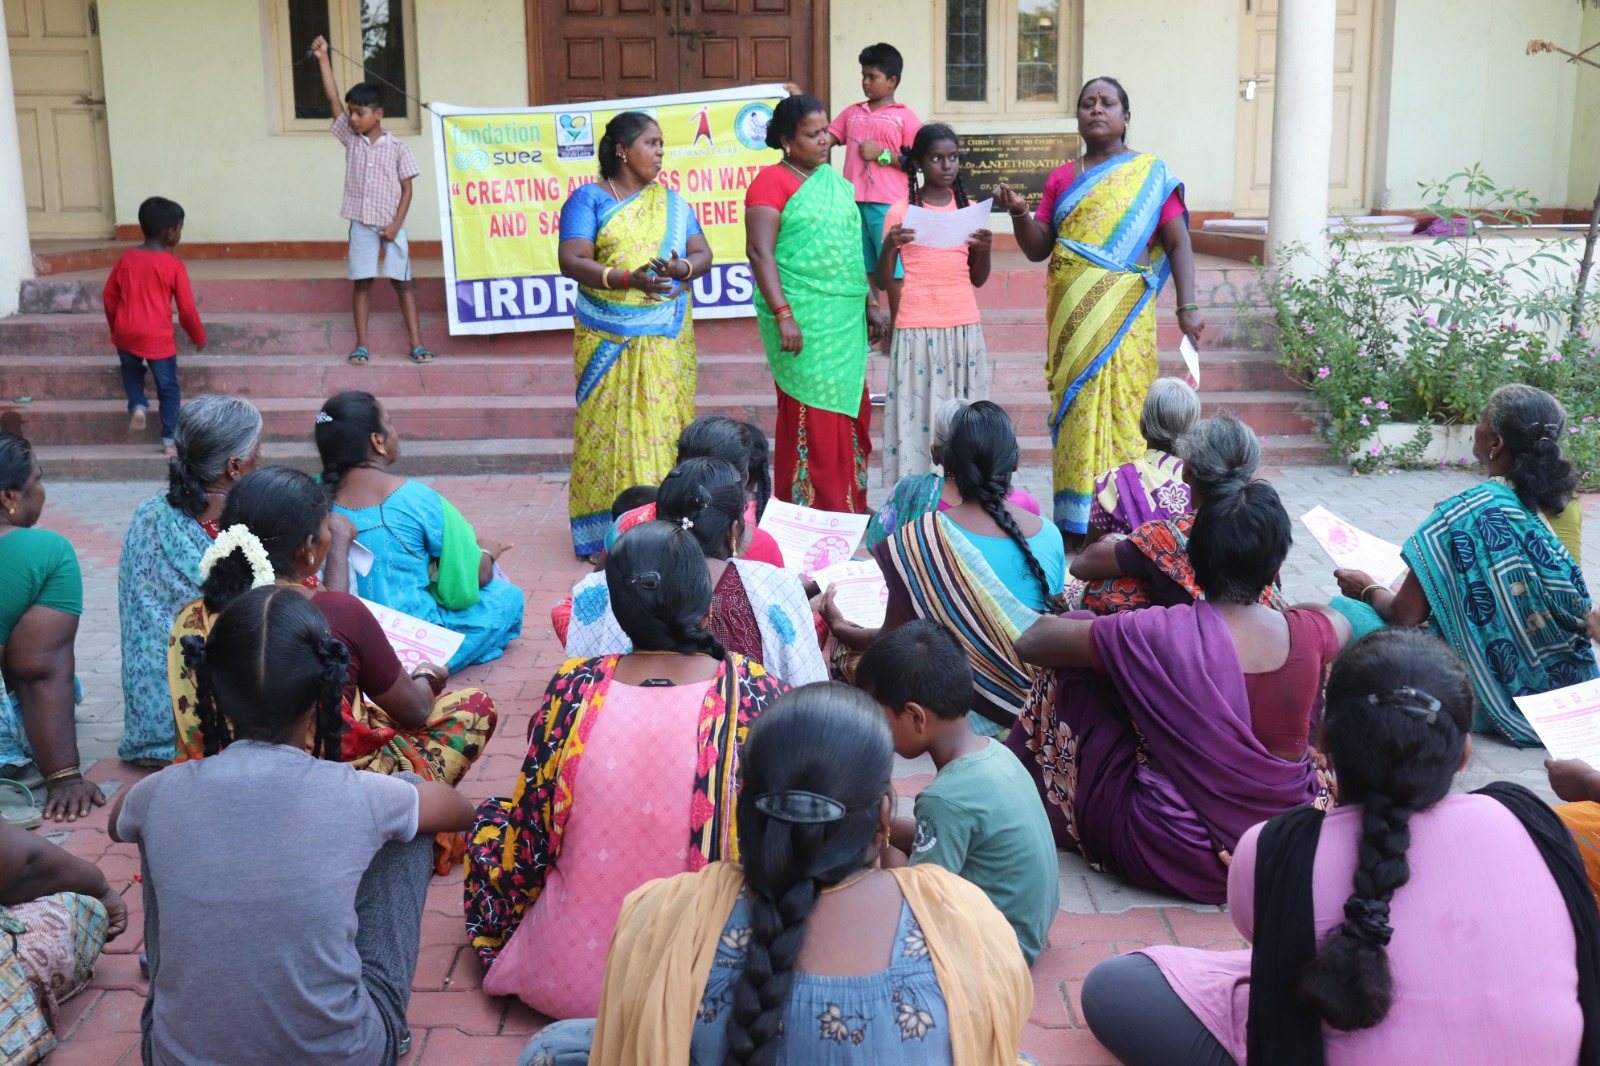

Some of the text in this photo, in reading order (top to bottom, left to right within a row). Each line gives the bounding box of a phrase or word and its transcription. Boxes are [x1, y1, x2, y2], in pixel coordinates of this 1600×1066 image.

[453, 121, 541, 146] fondation
[967, 138, 995, 146] CHRIST
[1034, 137, 1064, 145] CHURCH
[493, 150, 543, 166] suez
[465, 176, 560, 206] CREATING
[687, 166, 713, 193] ON
[718, 164, 769, 191] WAT
[490, 212, 528, 238] AND
